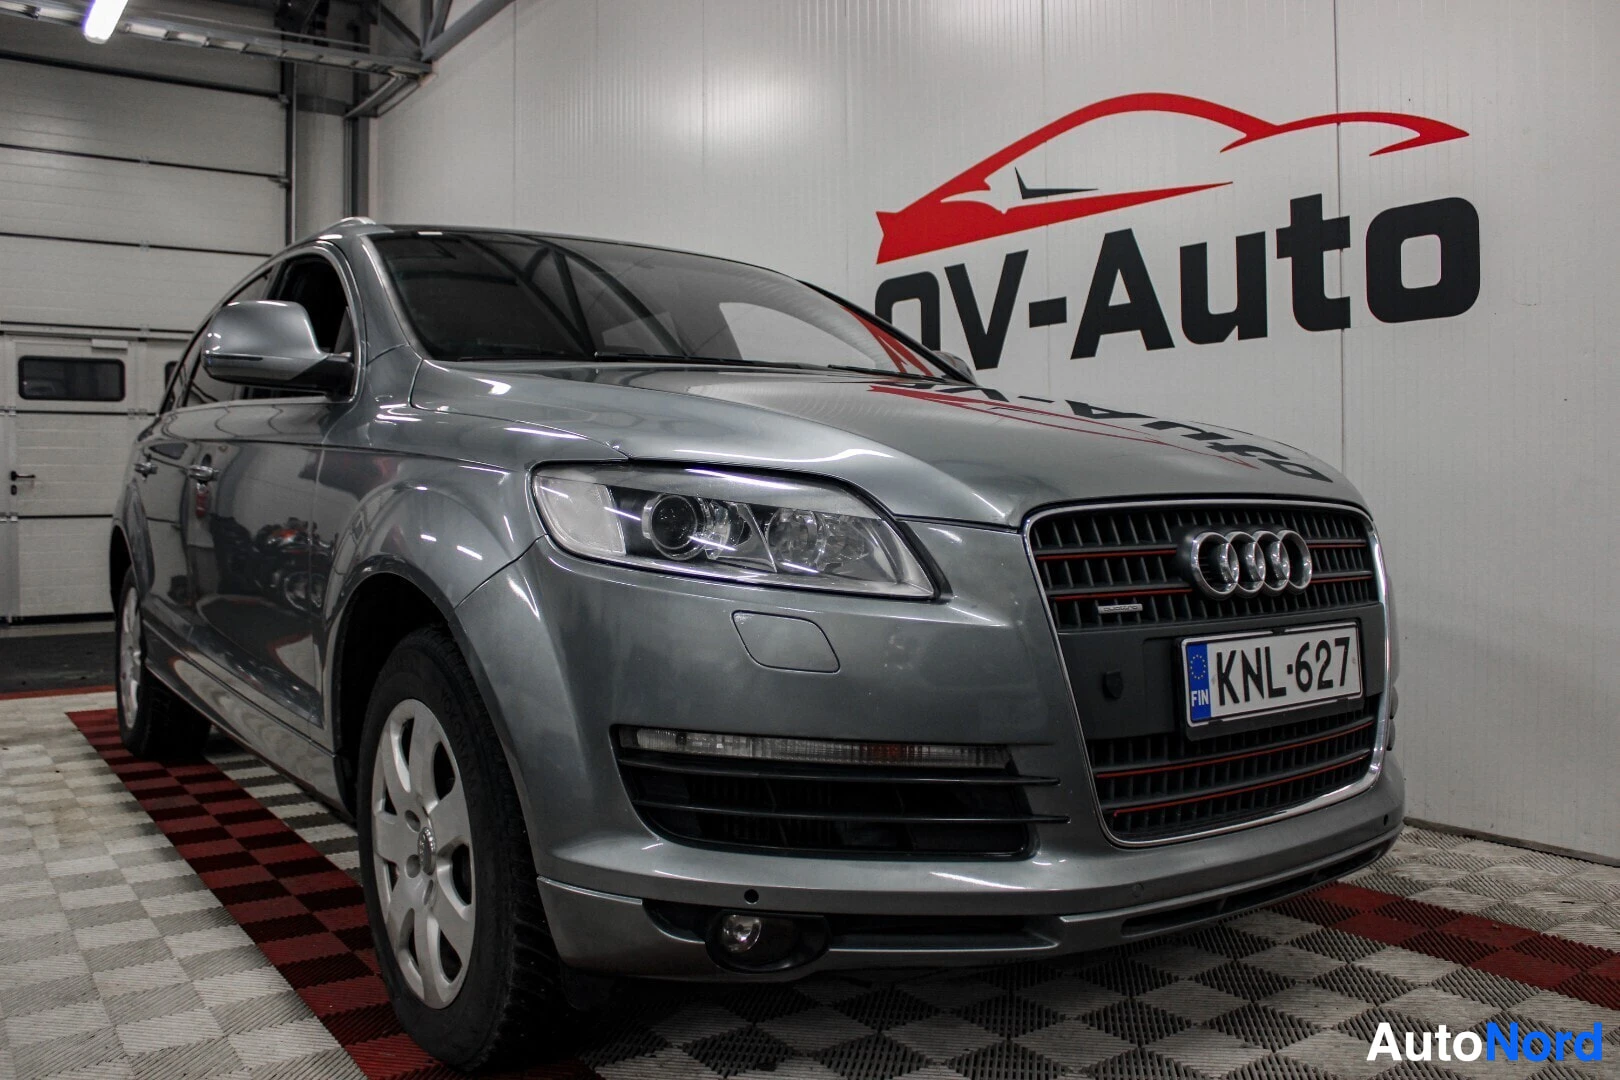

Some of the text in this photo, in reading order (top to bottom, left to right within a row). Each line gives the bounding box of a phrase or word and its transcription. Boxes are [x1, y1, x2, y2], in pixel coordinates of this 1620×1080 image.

[875, 193, 1481, 371] OV-Auto
[1103, 605, 1139, 613] quattro
[1191, 688, 1210, 707] FIN
